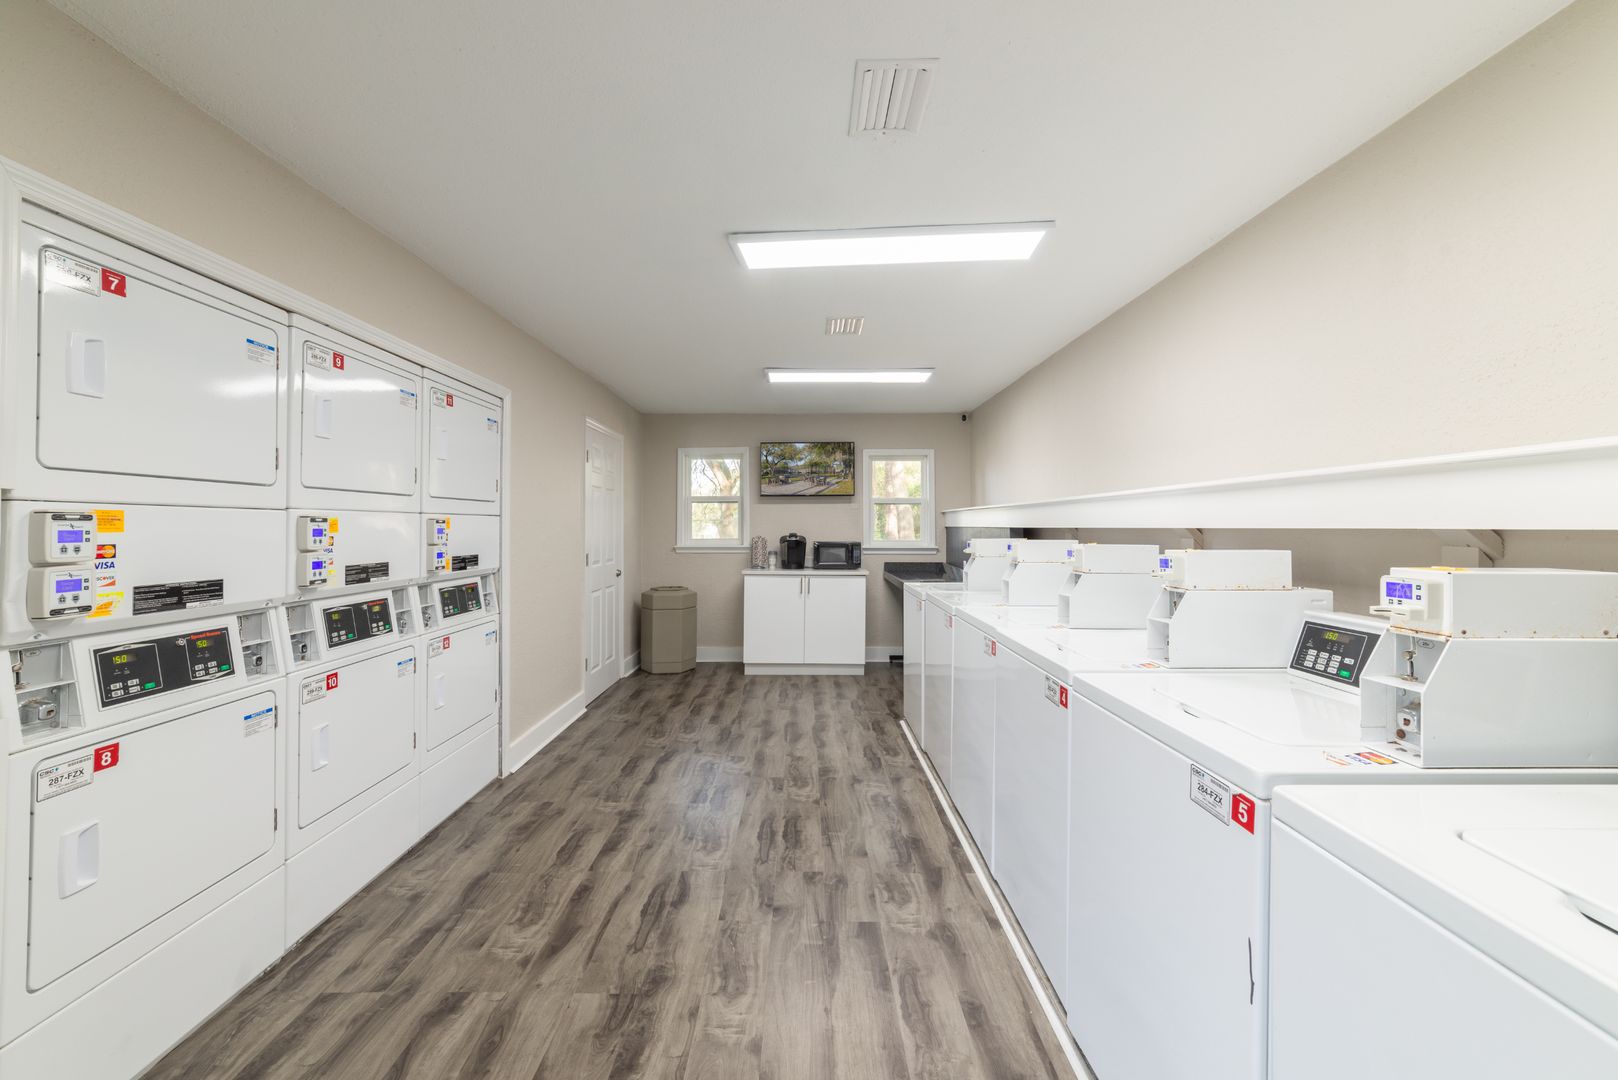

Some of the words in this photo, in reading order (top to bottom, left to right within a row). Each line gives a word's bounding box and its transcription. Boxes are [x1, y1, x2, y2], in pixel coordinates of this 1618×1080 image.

[108, 276, 119, 290] 7
[95, 561, 116, 570] VISA
[328, 677, 336, 688] 10
[100, 751, 112, 766] 8
[48, 768, 85, 787] 287-FZX
[1238, 801, 1248, 823] 5
